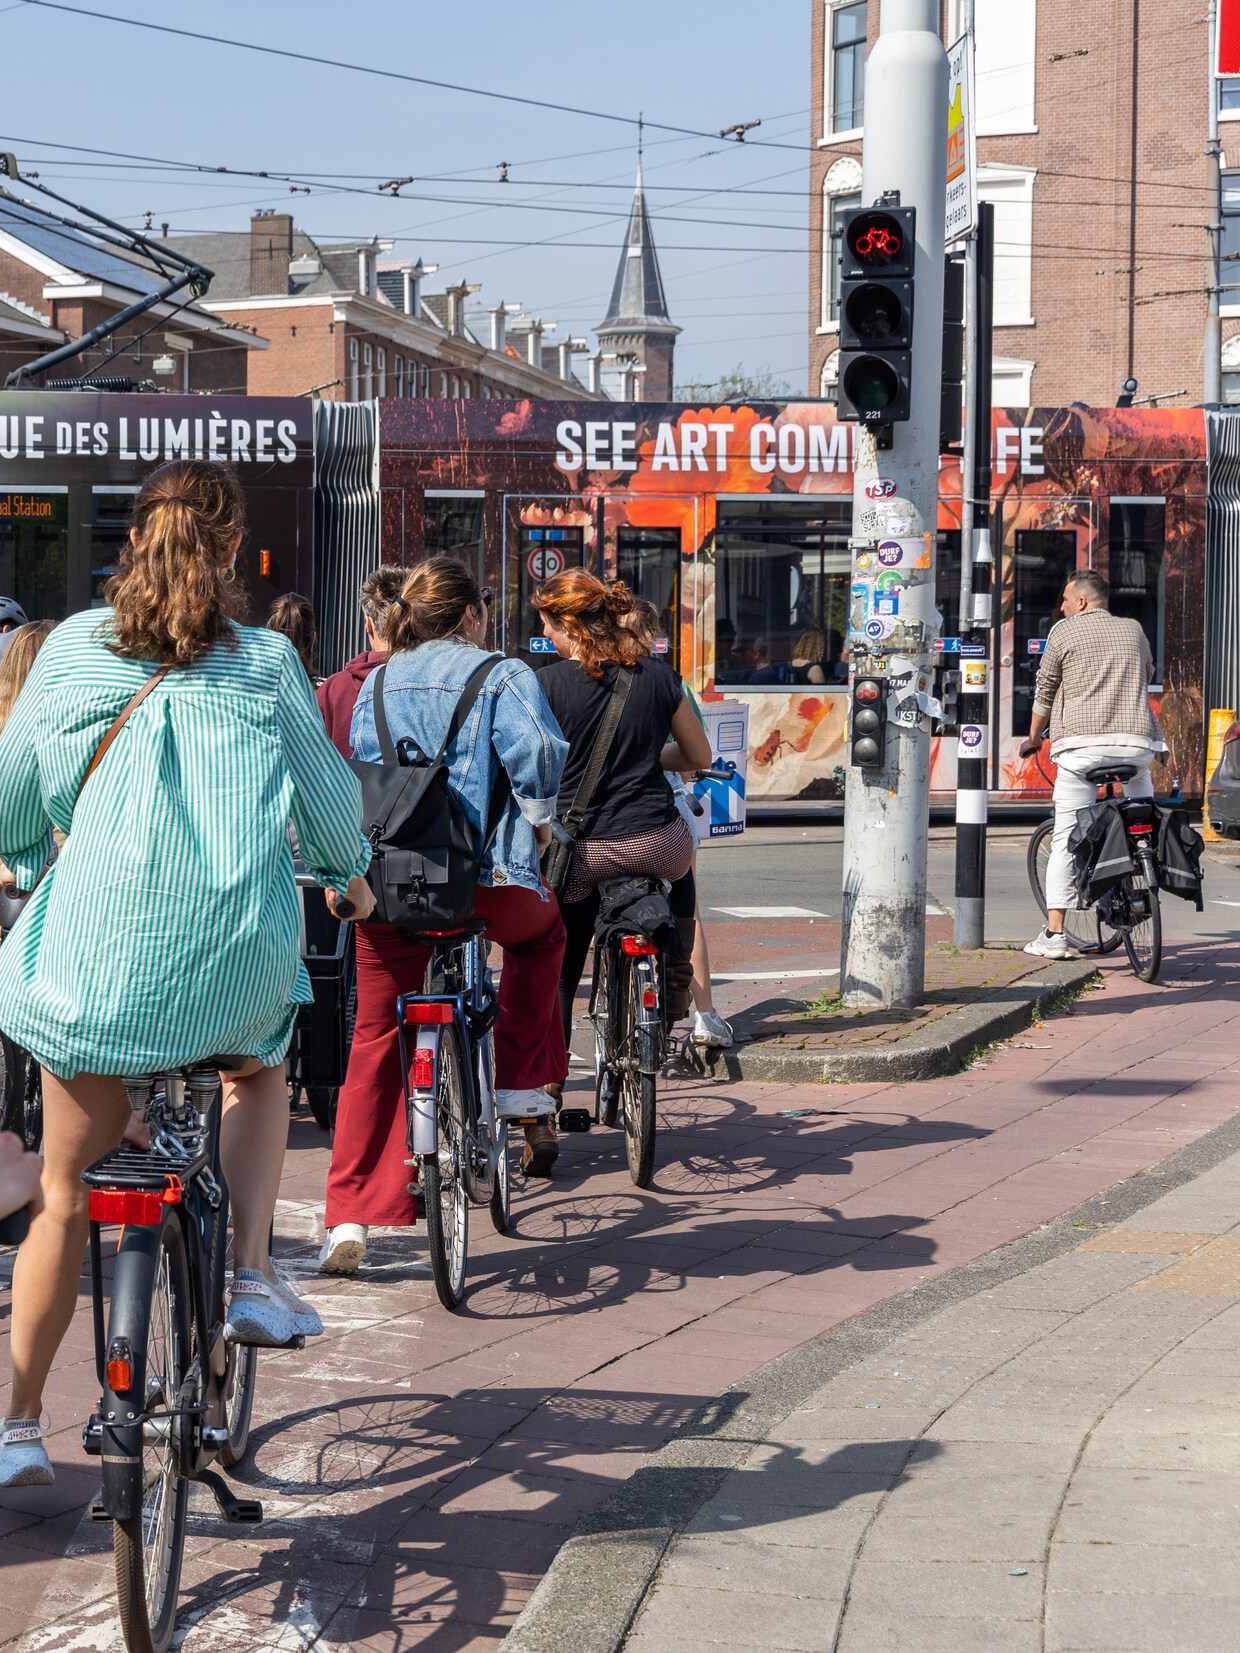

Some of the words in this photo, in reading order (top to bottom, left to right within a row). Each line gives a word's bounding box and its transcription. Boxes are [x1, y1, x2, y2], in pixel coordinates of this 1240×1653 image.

[865, 410, 881, 419] 221
[56, 421, 109, 456] DES
[119, 410, 297, 463] LUMIÈRES
[556, 420, 637, 471] SEE
[651, 422, 735, 472] ART
[749, 423, 856, 474] COM
[13, 494, 52, 517] Station
[880, 547, 900, 556] DURF
[883, 554, 898, 563] JE?
[535, 557, 558, 571] 30
